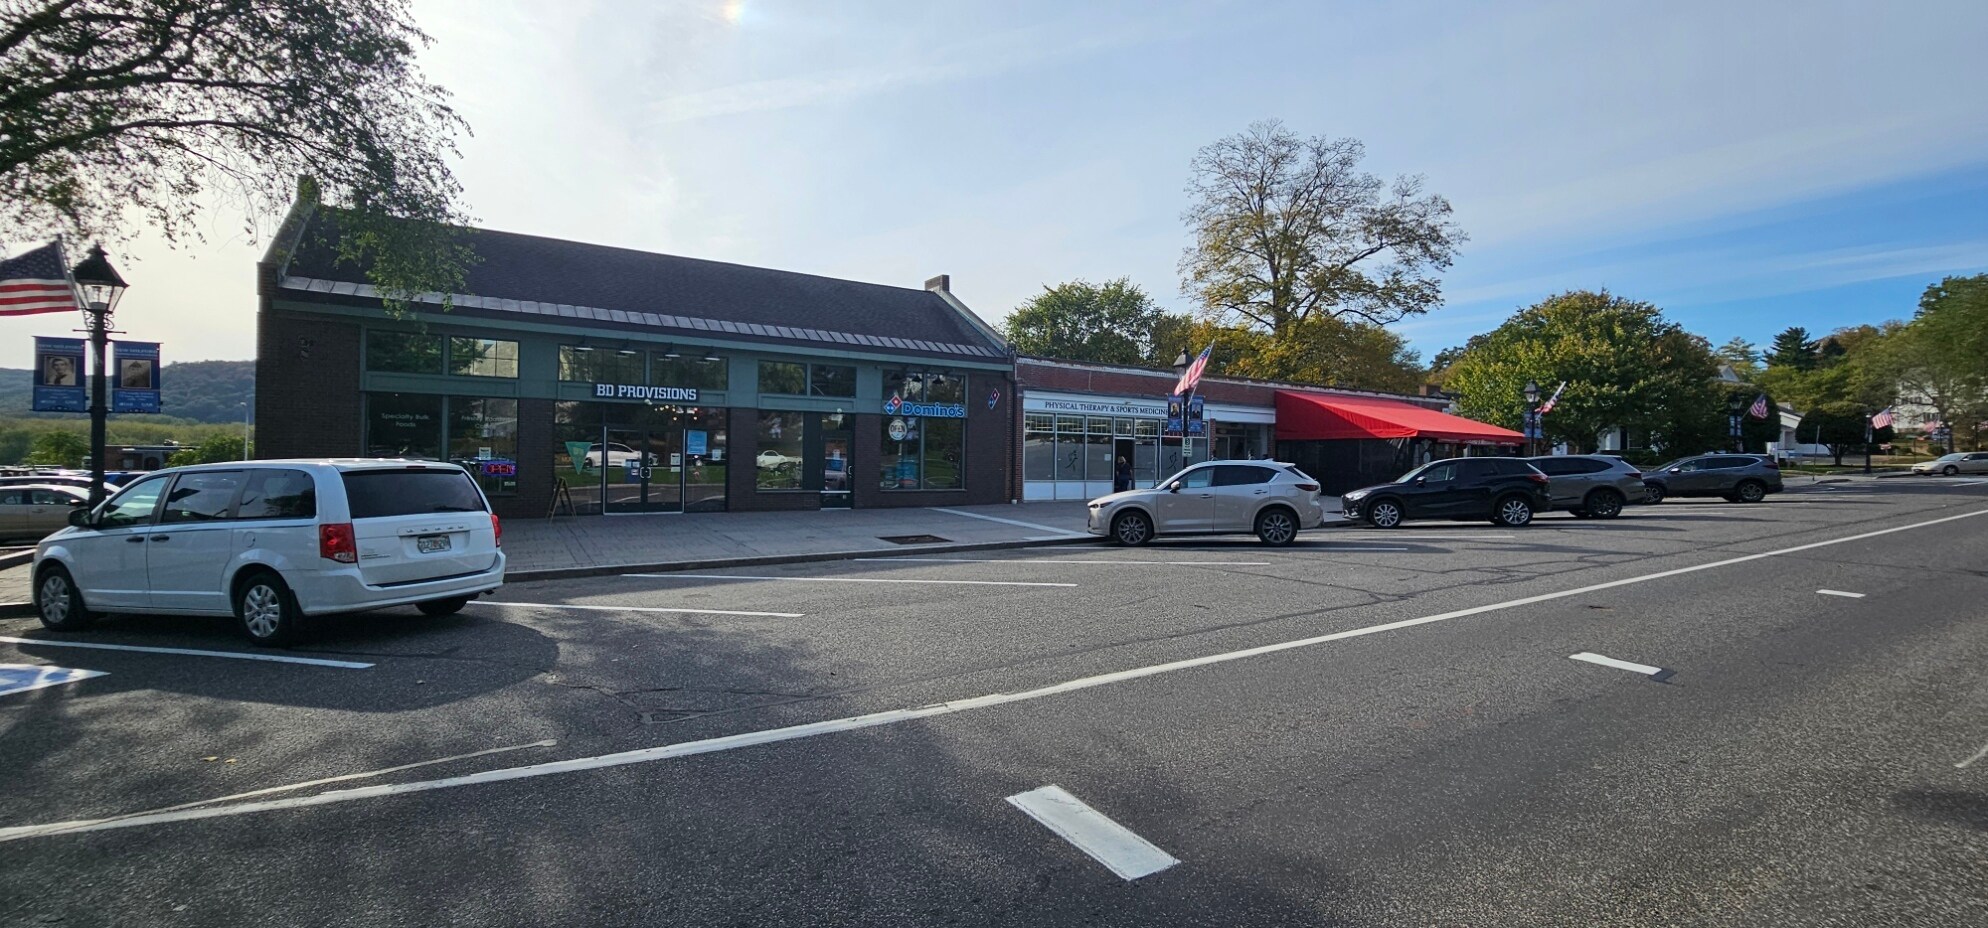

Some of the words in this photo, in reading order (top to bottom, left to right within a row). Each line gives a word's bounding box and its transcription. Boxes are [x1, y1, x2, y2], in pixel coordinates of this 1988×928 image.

[596, 384, 614, 396] BD
[618, 385, 697, 400] PROVISIONS
[901, 401, 965, 417] Domino's
[1045, 401, 1078, 410] PHYSICAL
[1080, 403, 1109, 412] THERAPY
[1116, 405, 1139, 414] SPORTS
